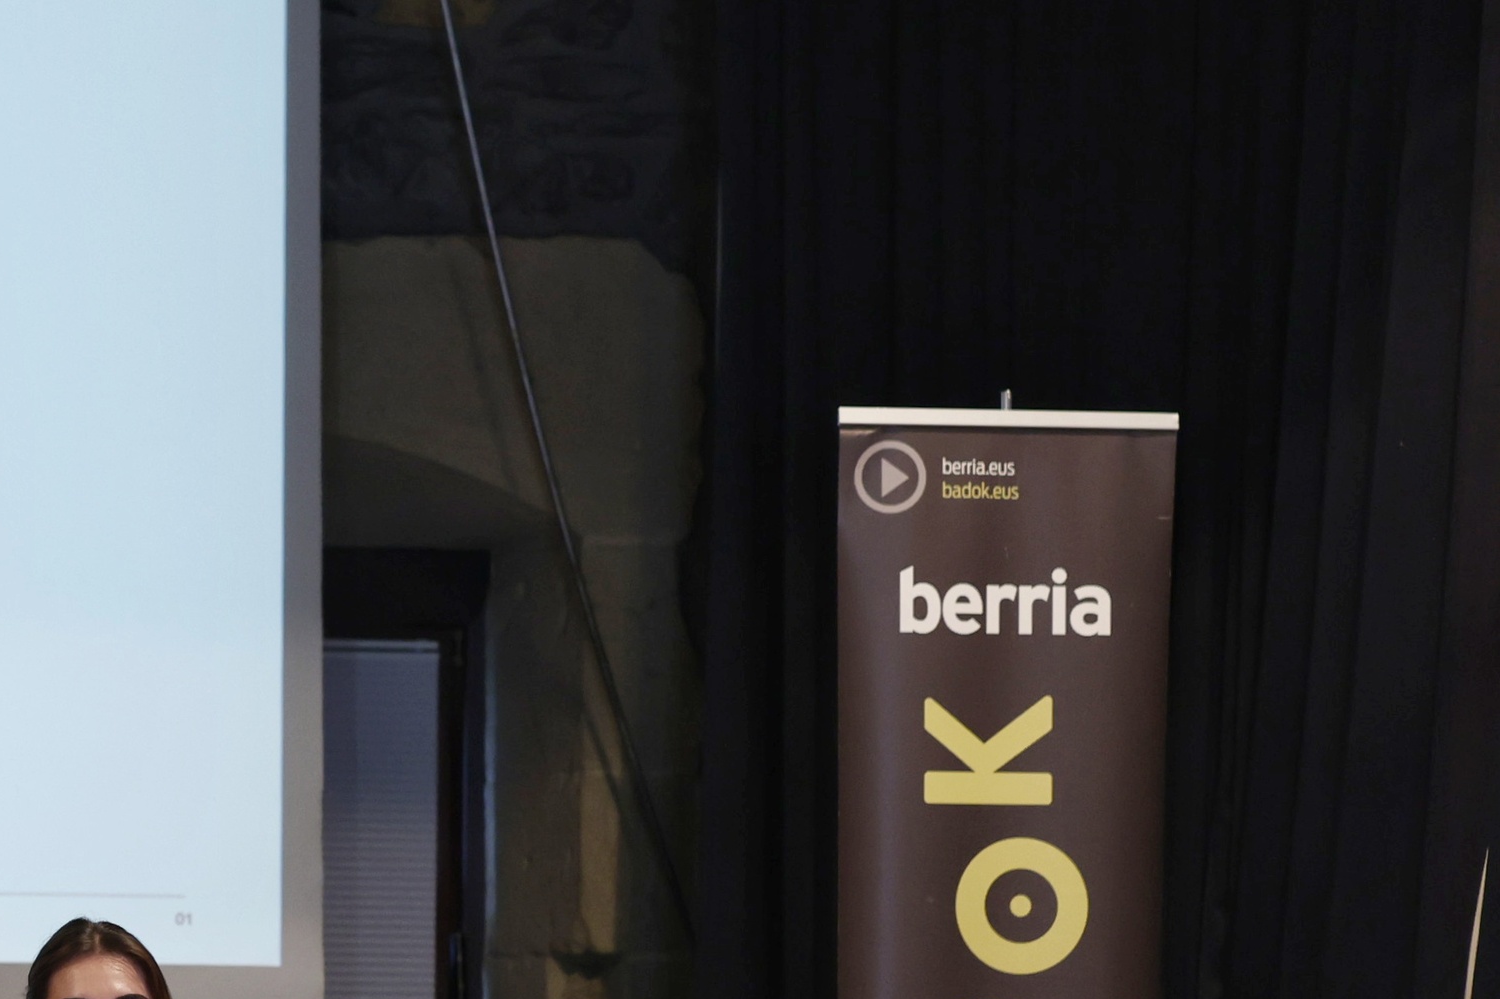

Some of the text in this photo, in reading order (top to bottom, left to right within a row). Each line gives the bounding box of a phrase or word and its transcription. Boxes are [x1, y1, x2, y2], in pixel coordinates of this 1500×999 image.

[942, 457, 1015, 476] berria.eus
[942, 481, 1019, 500] badok.eus
[899, 565, 1111, 637] berria
[174, 911, 192, 926] 01
